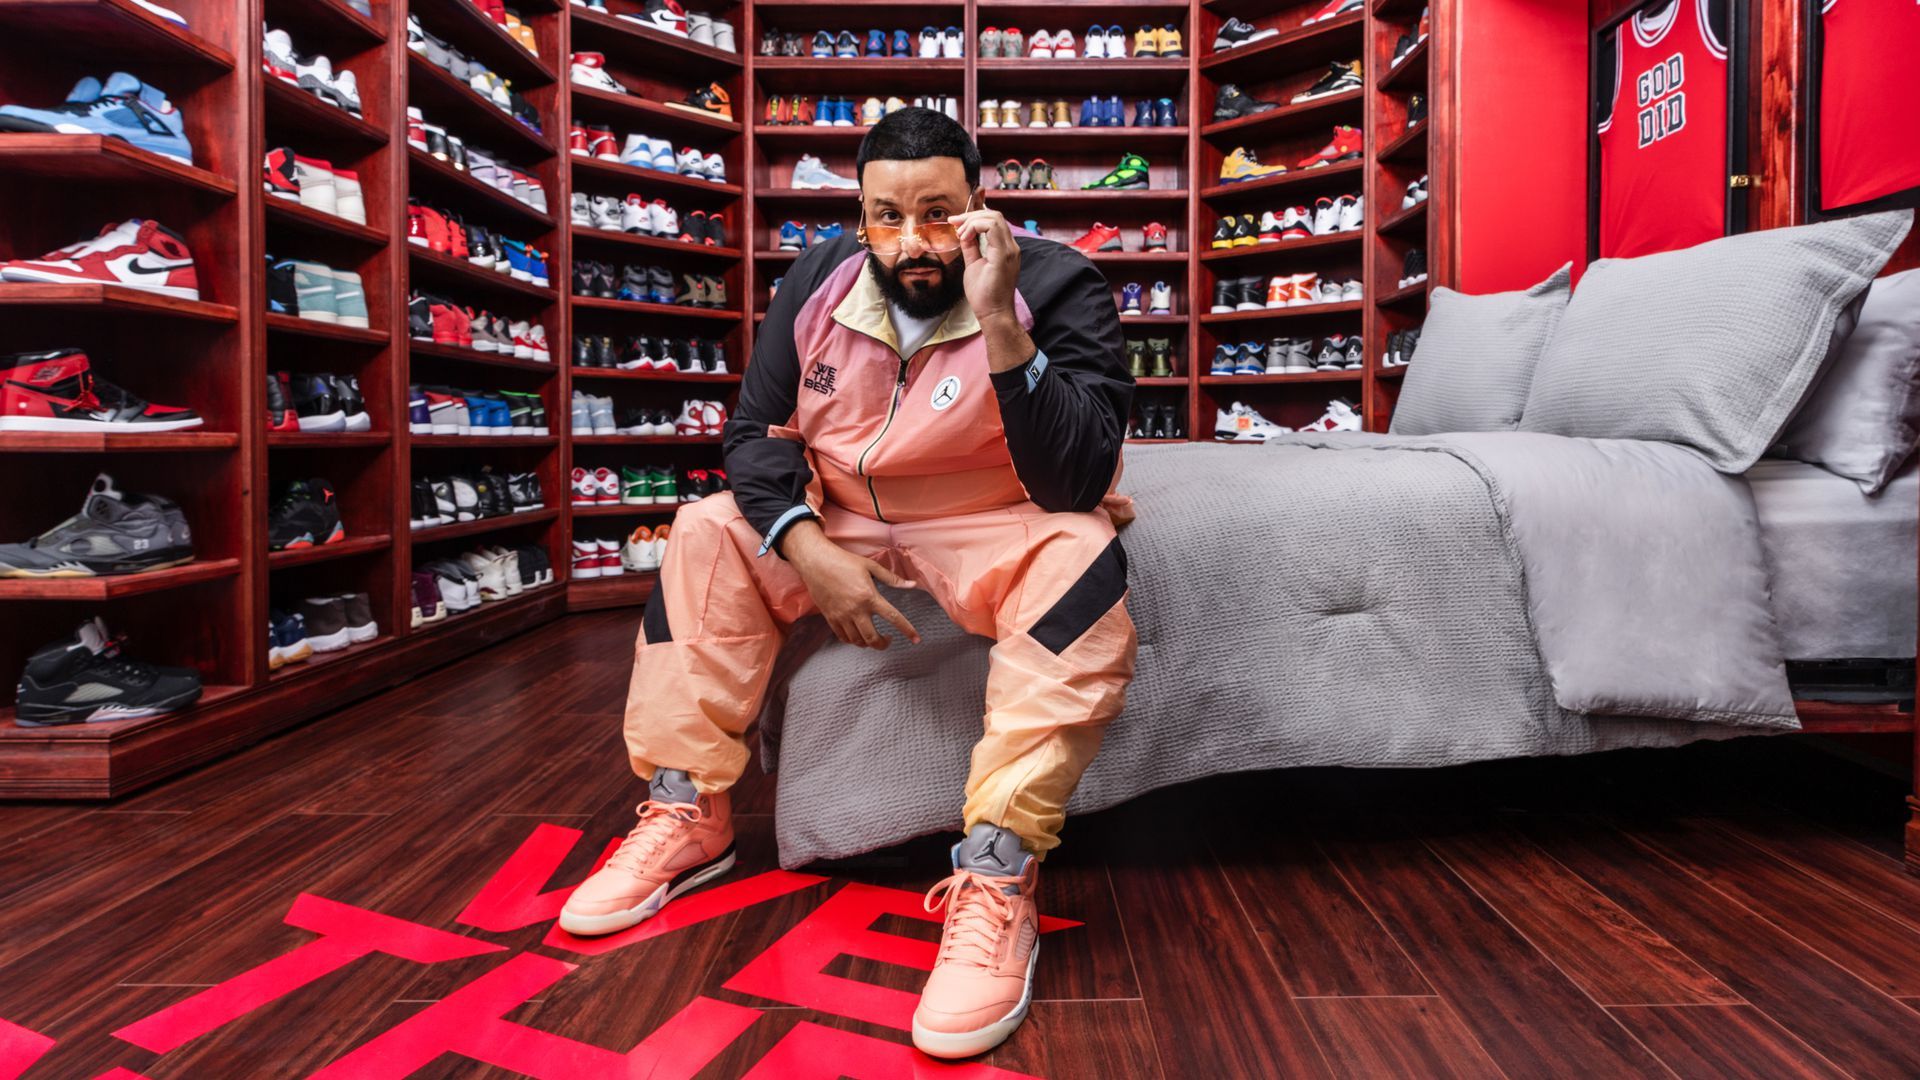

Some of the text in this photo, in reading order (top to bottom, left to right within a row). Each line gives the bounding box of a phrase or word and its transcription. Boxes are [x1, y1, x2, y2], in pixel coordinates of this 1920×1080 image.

[1637, 52, 1685, 107] GOD
[1638, 91, 1686, 149] DID
[812, 370, 836, 388] THE
[816, 361, 837, 378] WE
[804, 378, 836, 397] BEST
[133, 538, 149, 550] 23
[110, 893, 1046, 1080] TH
